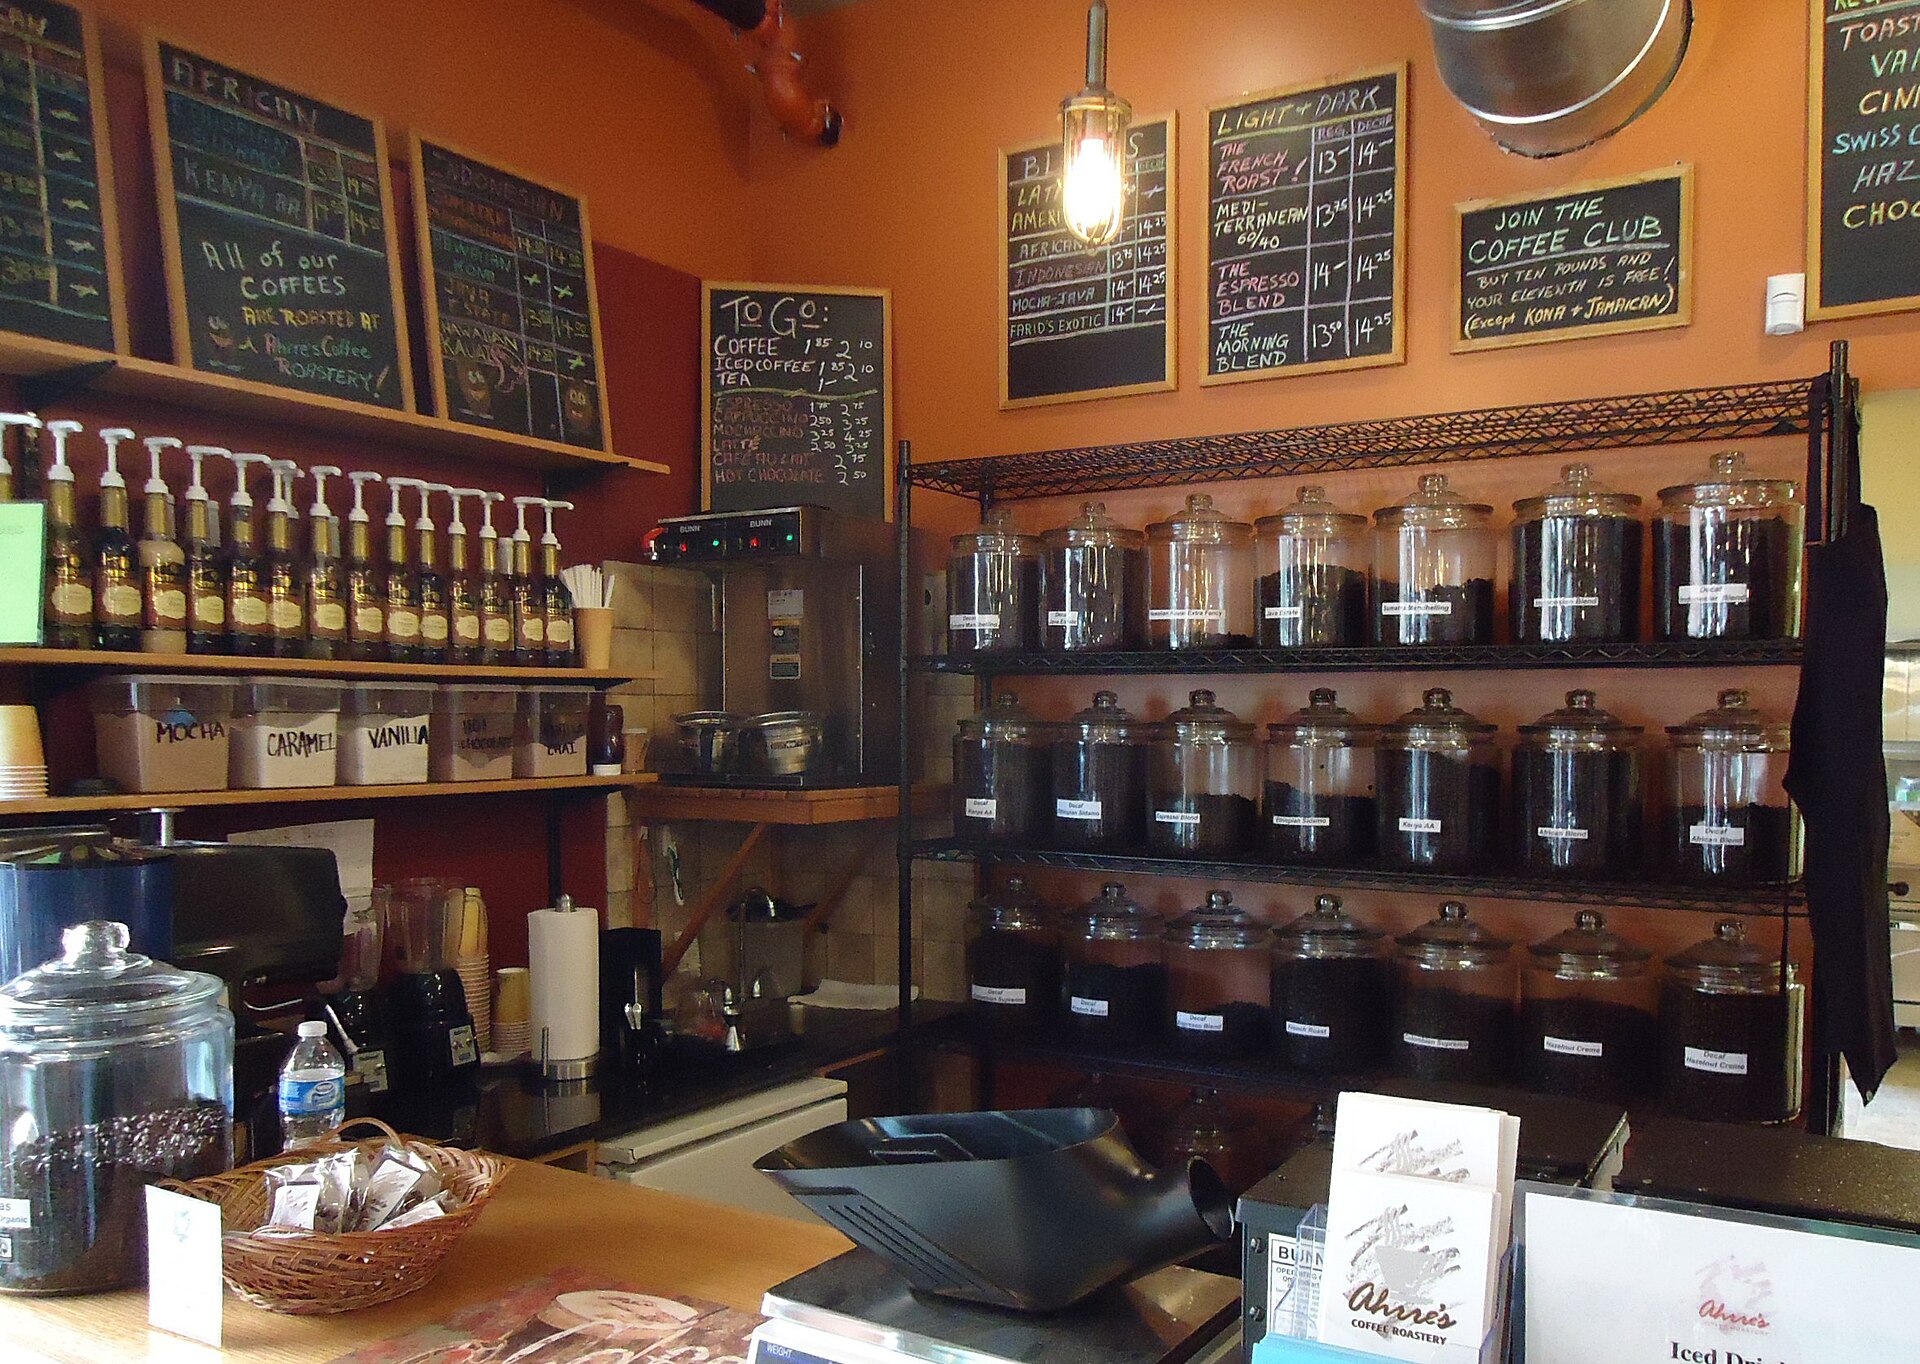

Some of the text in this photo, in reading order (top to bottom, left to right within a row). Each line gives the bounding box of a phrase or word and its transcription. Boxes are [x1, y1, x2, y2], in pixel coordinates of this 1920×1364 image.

[173, 58, 318, 133] AFRICAN
[1217, 104, 1295, 136] LIGHT
[1315, 85, 1380, 116] DARK
[1356, 114, 1392, 134] DECAF
[1219, 141, 1249, 161] THE
[1832, 123, 1901, 155] SWISS
[1216, 149, 1289, 178] FRENCH
[184, 157, 266, 209] KENYA
[1212, 205, 1309, 238] TERRANEAN
[1493, 196, 1606, 232] JOIN THE
[1019, 239, 1084, 260] AFRICAN
[1236, 229, 1280, 250] 60/40
[1467, 214, 1663, 264] COFFEE CLUB
[200, 239, 339, 272] All of our
[1016, 261, 1106, 287] INDONESIAN
[1218, 261, 1251, 281] THE
[1476, 251, 1654, 290] BUY TEN POUNDS AND
[240, 275, 347, 300] COFFEES
[1215, 270, 1300, 297] ESPRESSO
[1466, 294, 1504, 310] YOUR
[1510, 279, 1588, 303] ELEVENTH
[1596, 273, 1616, 288] IS
[1011, 286, 1096, 314] MOCHA-JAVA
[1218, 291, 1286, 317] BLEND
[279, 308, 354, 328] ROASTED
[359, 311, 382, 331] AT
[1009, 321, 1055, 339] FARID'S
[1058, 313, 1102, 334] EXOTIC
[1523, 305, 1568, 327] KONA
[1217, 321, 1255, 341] THE
[713, 335, 782, 356] COFFEE
[1215, 332, 1290, 357] MORNING
[714, 357, 817, 374] ICED COFFEE
[1216, 351, 1288, 374] BLEND
[716, 371, 752, 387] TEA
[714, 468, 825, 484] HOT CHOCOLATE
[679, 524, 702, 533] BUNN
[749, 518, 773, 528] BUNN
[156, 721, 226, 744] MOCHA
[266, 730, 337, 758] CARAMEL
[1703, 1050, 1726, 1060] Decaf
[1350, 1318, 1447, 1346] COFFEE ROASTERY
[765, 1343, 792, 1358] WEIGHT
[1671, 1340, 1718, 1364] Iced
